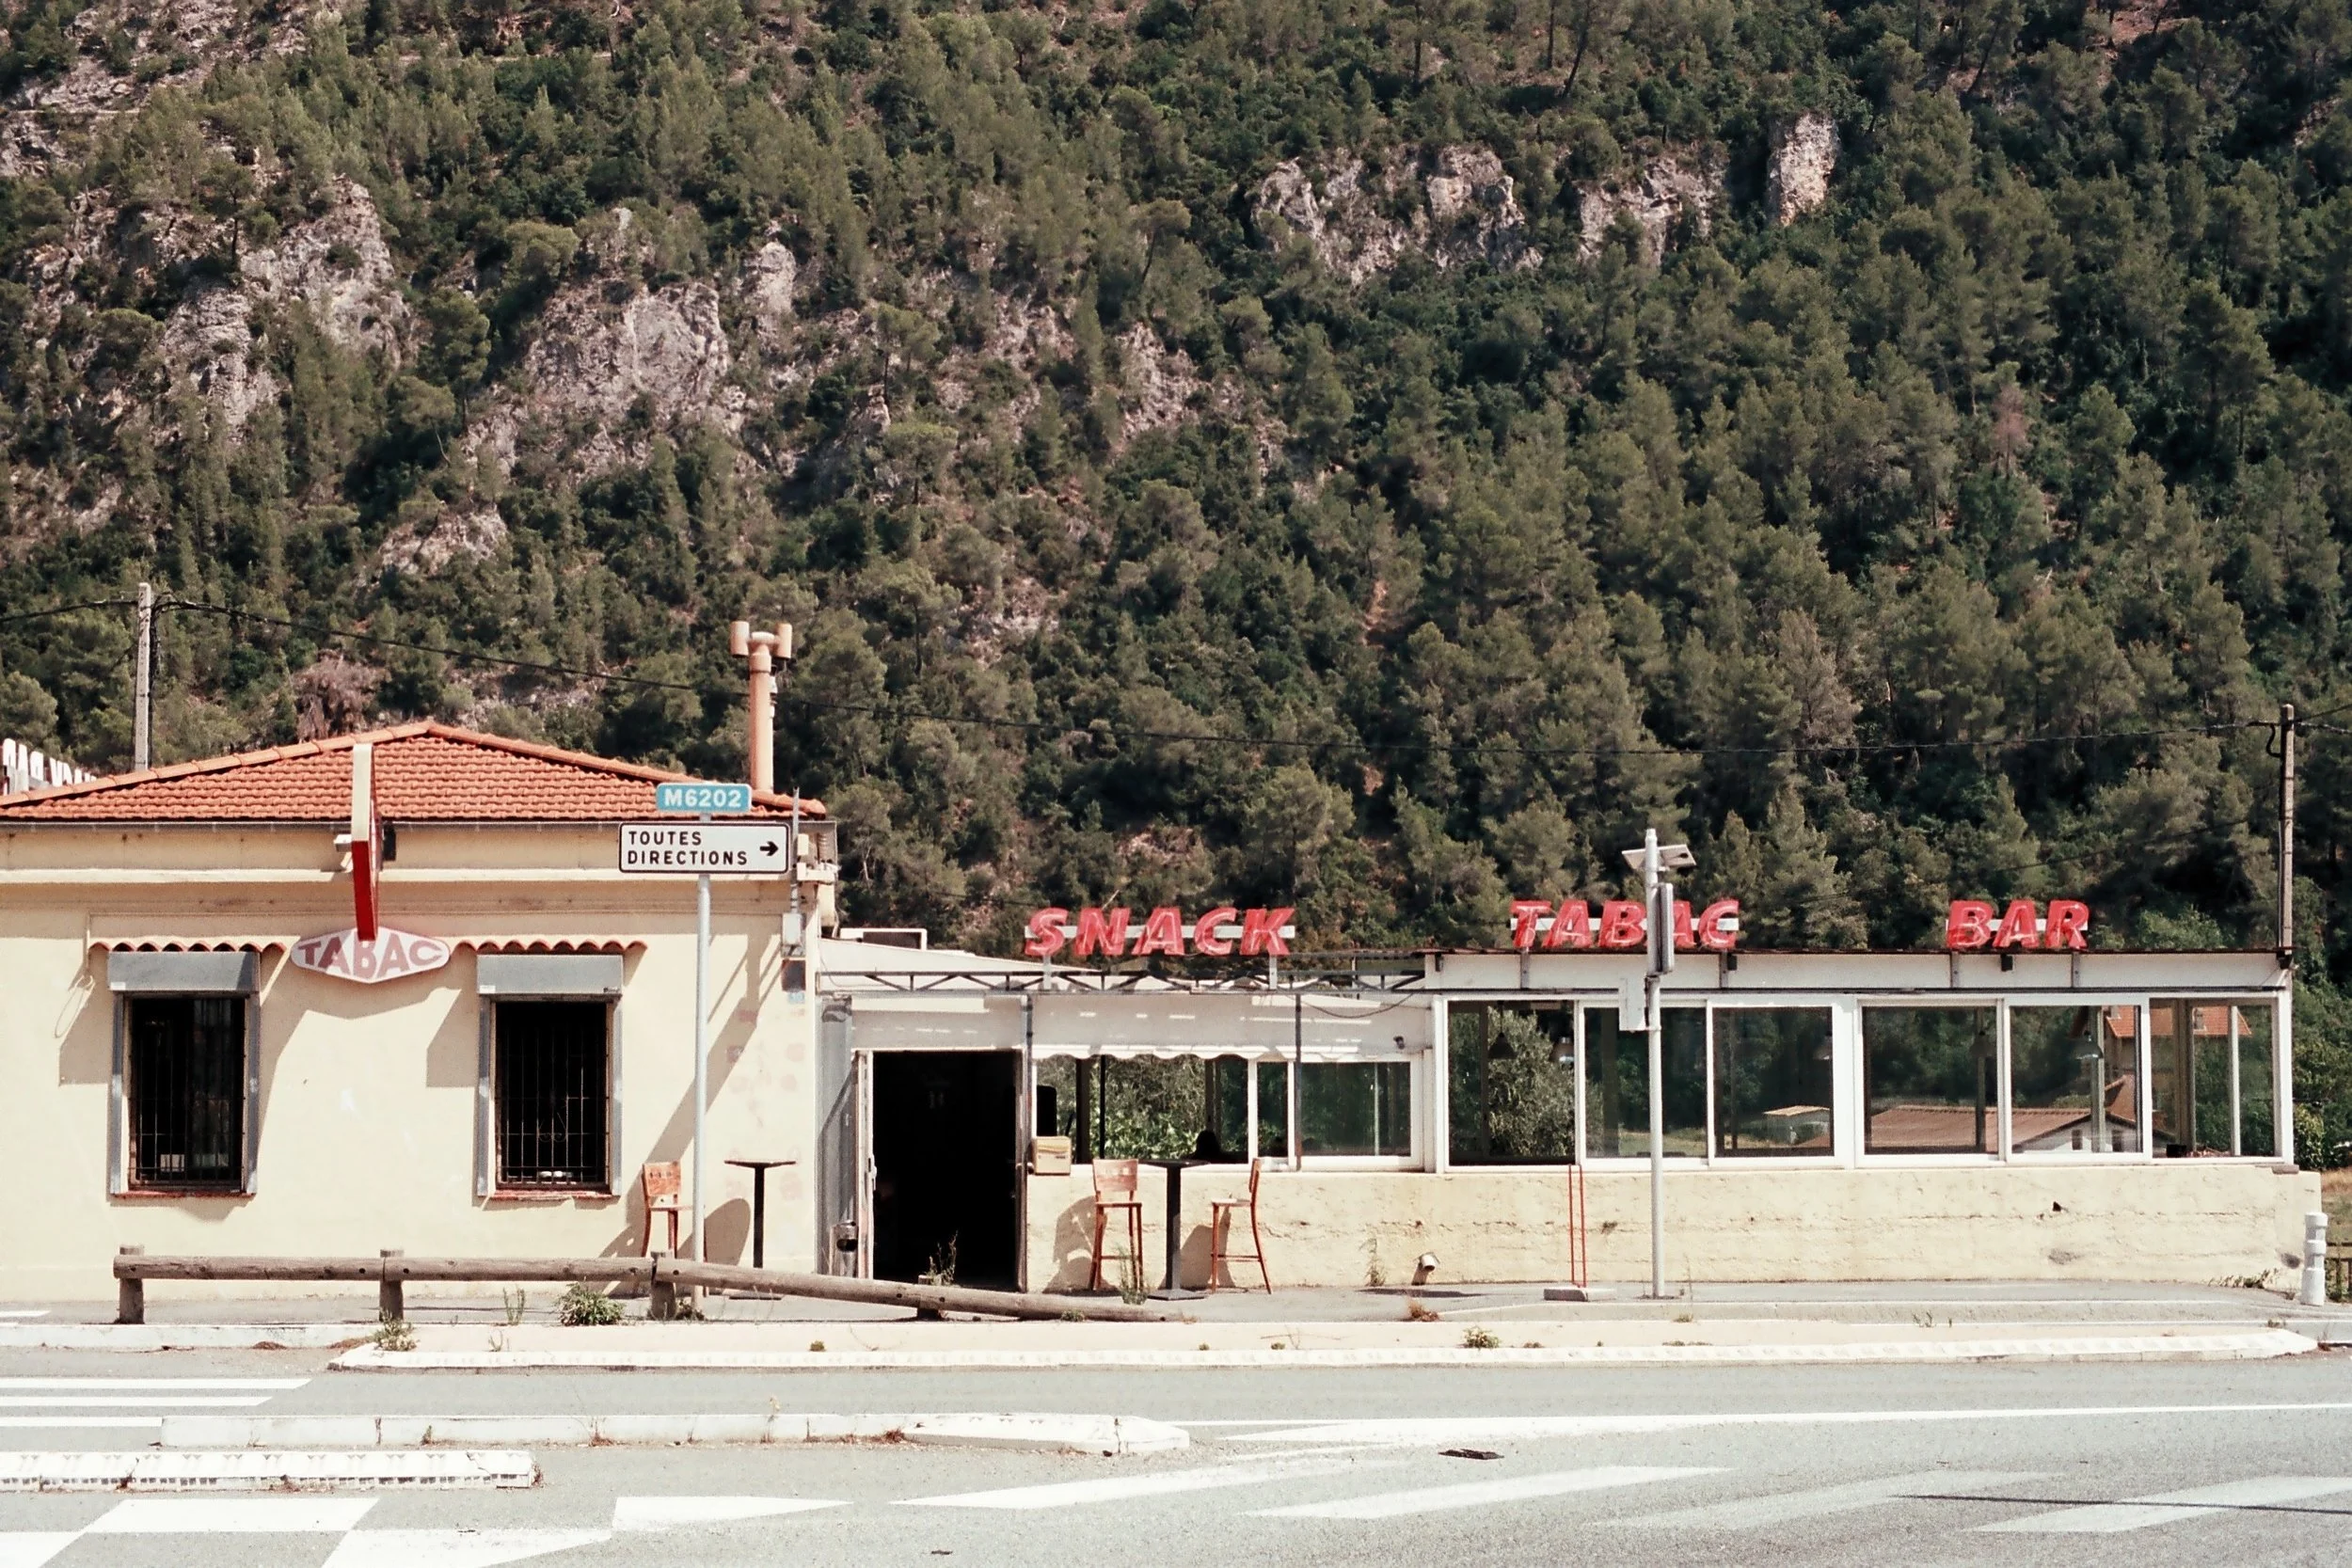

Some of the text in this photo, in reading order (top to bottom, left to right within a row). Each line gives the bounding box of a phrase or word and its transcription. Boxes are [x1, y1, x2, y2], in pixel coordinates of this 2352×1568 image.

[664, 789, 741, 808] M6202
[628, 831, 702, 846] TOUTES
[627, 850, 748, 865] DIRECTIONS
[1025, 906, 1295, 957] SNACK
[1946, 898, 2090, 949] BAR
[297, 932, 443, 979] TABAC
